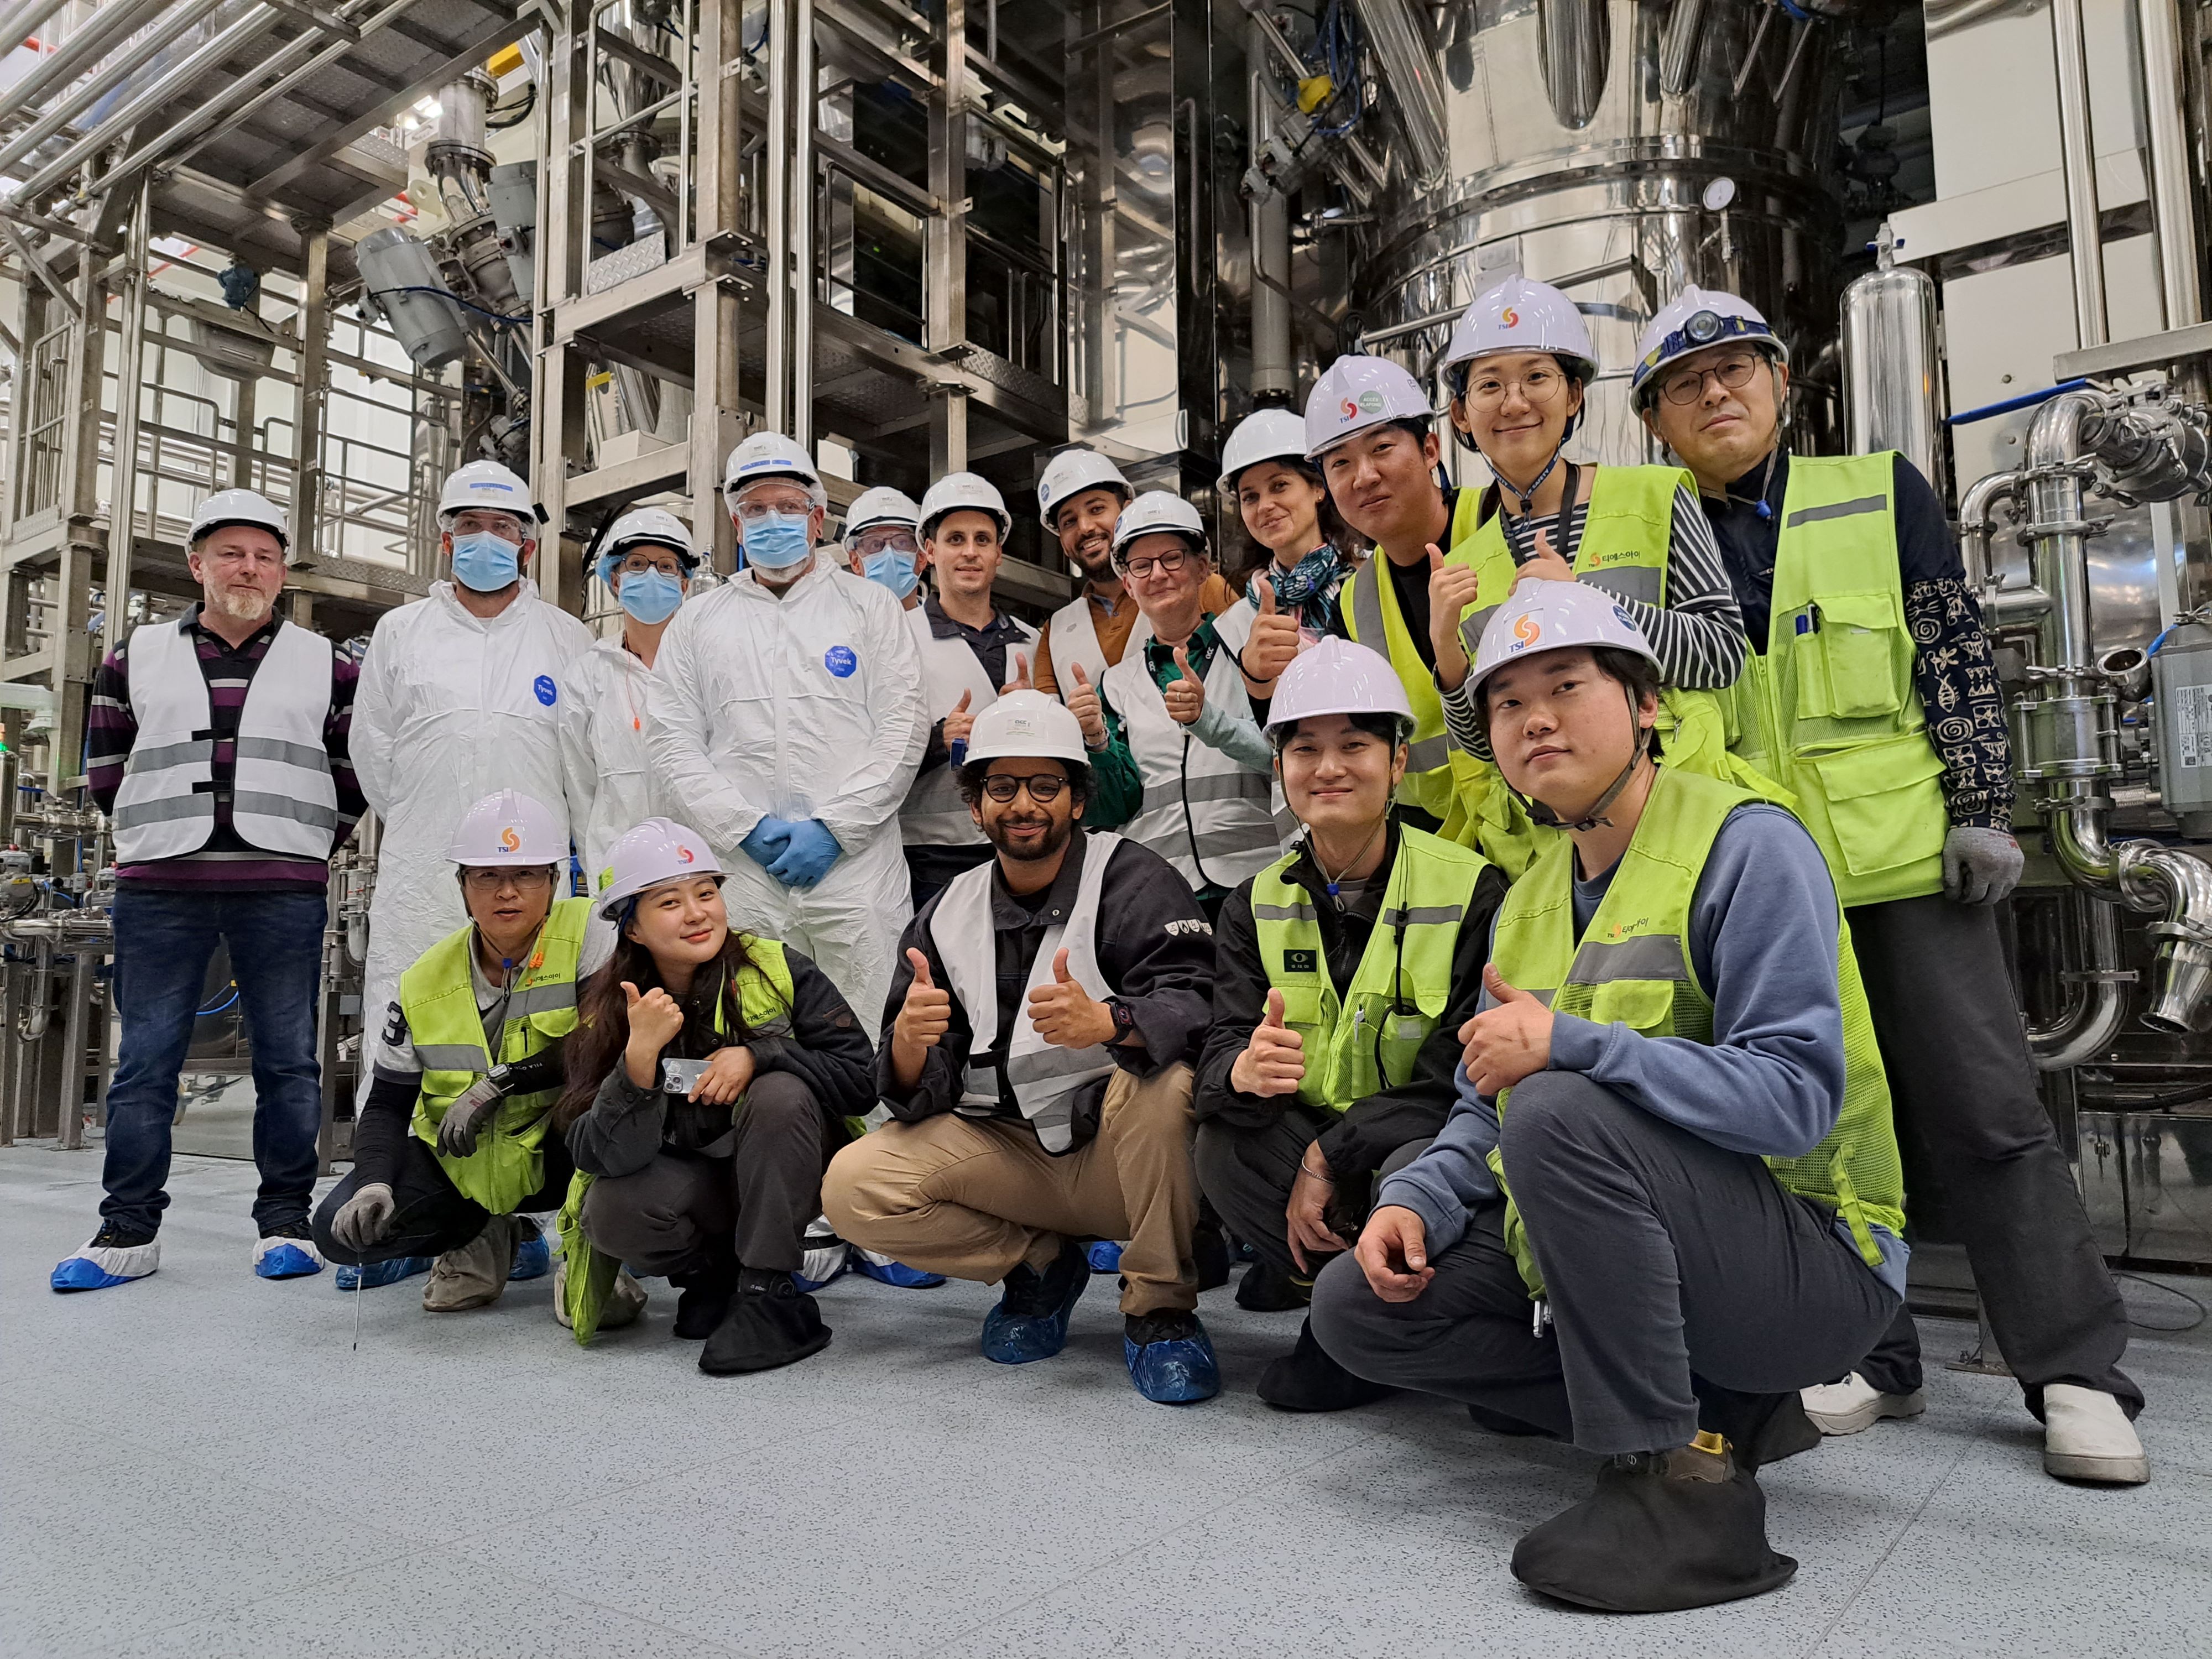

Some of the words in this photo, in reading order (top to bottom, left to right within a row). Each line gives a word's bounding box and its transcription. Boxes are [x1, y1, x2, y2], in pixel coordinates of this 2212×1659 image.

[1339, 415, 1349, 424] TSI
[1602, 550, 1640, 562] 티에스아이
[1509, 640, 1524, 653] TSI
[831, 656, 852, 665] Tyvek
[537, 684, 554, 696] Tyvek
[747, 1006, 776, 1022] 티에스아이
